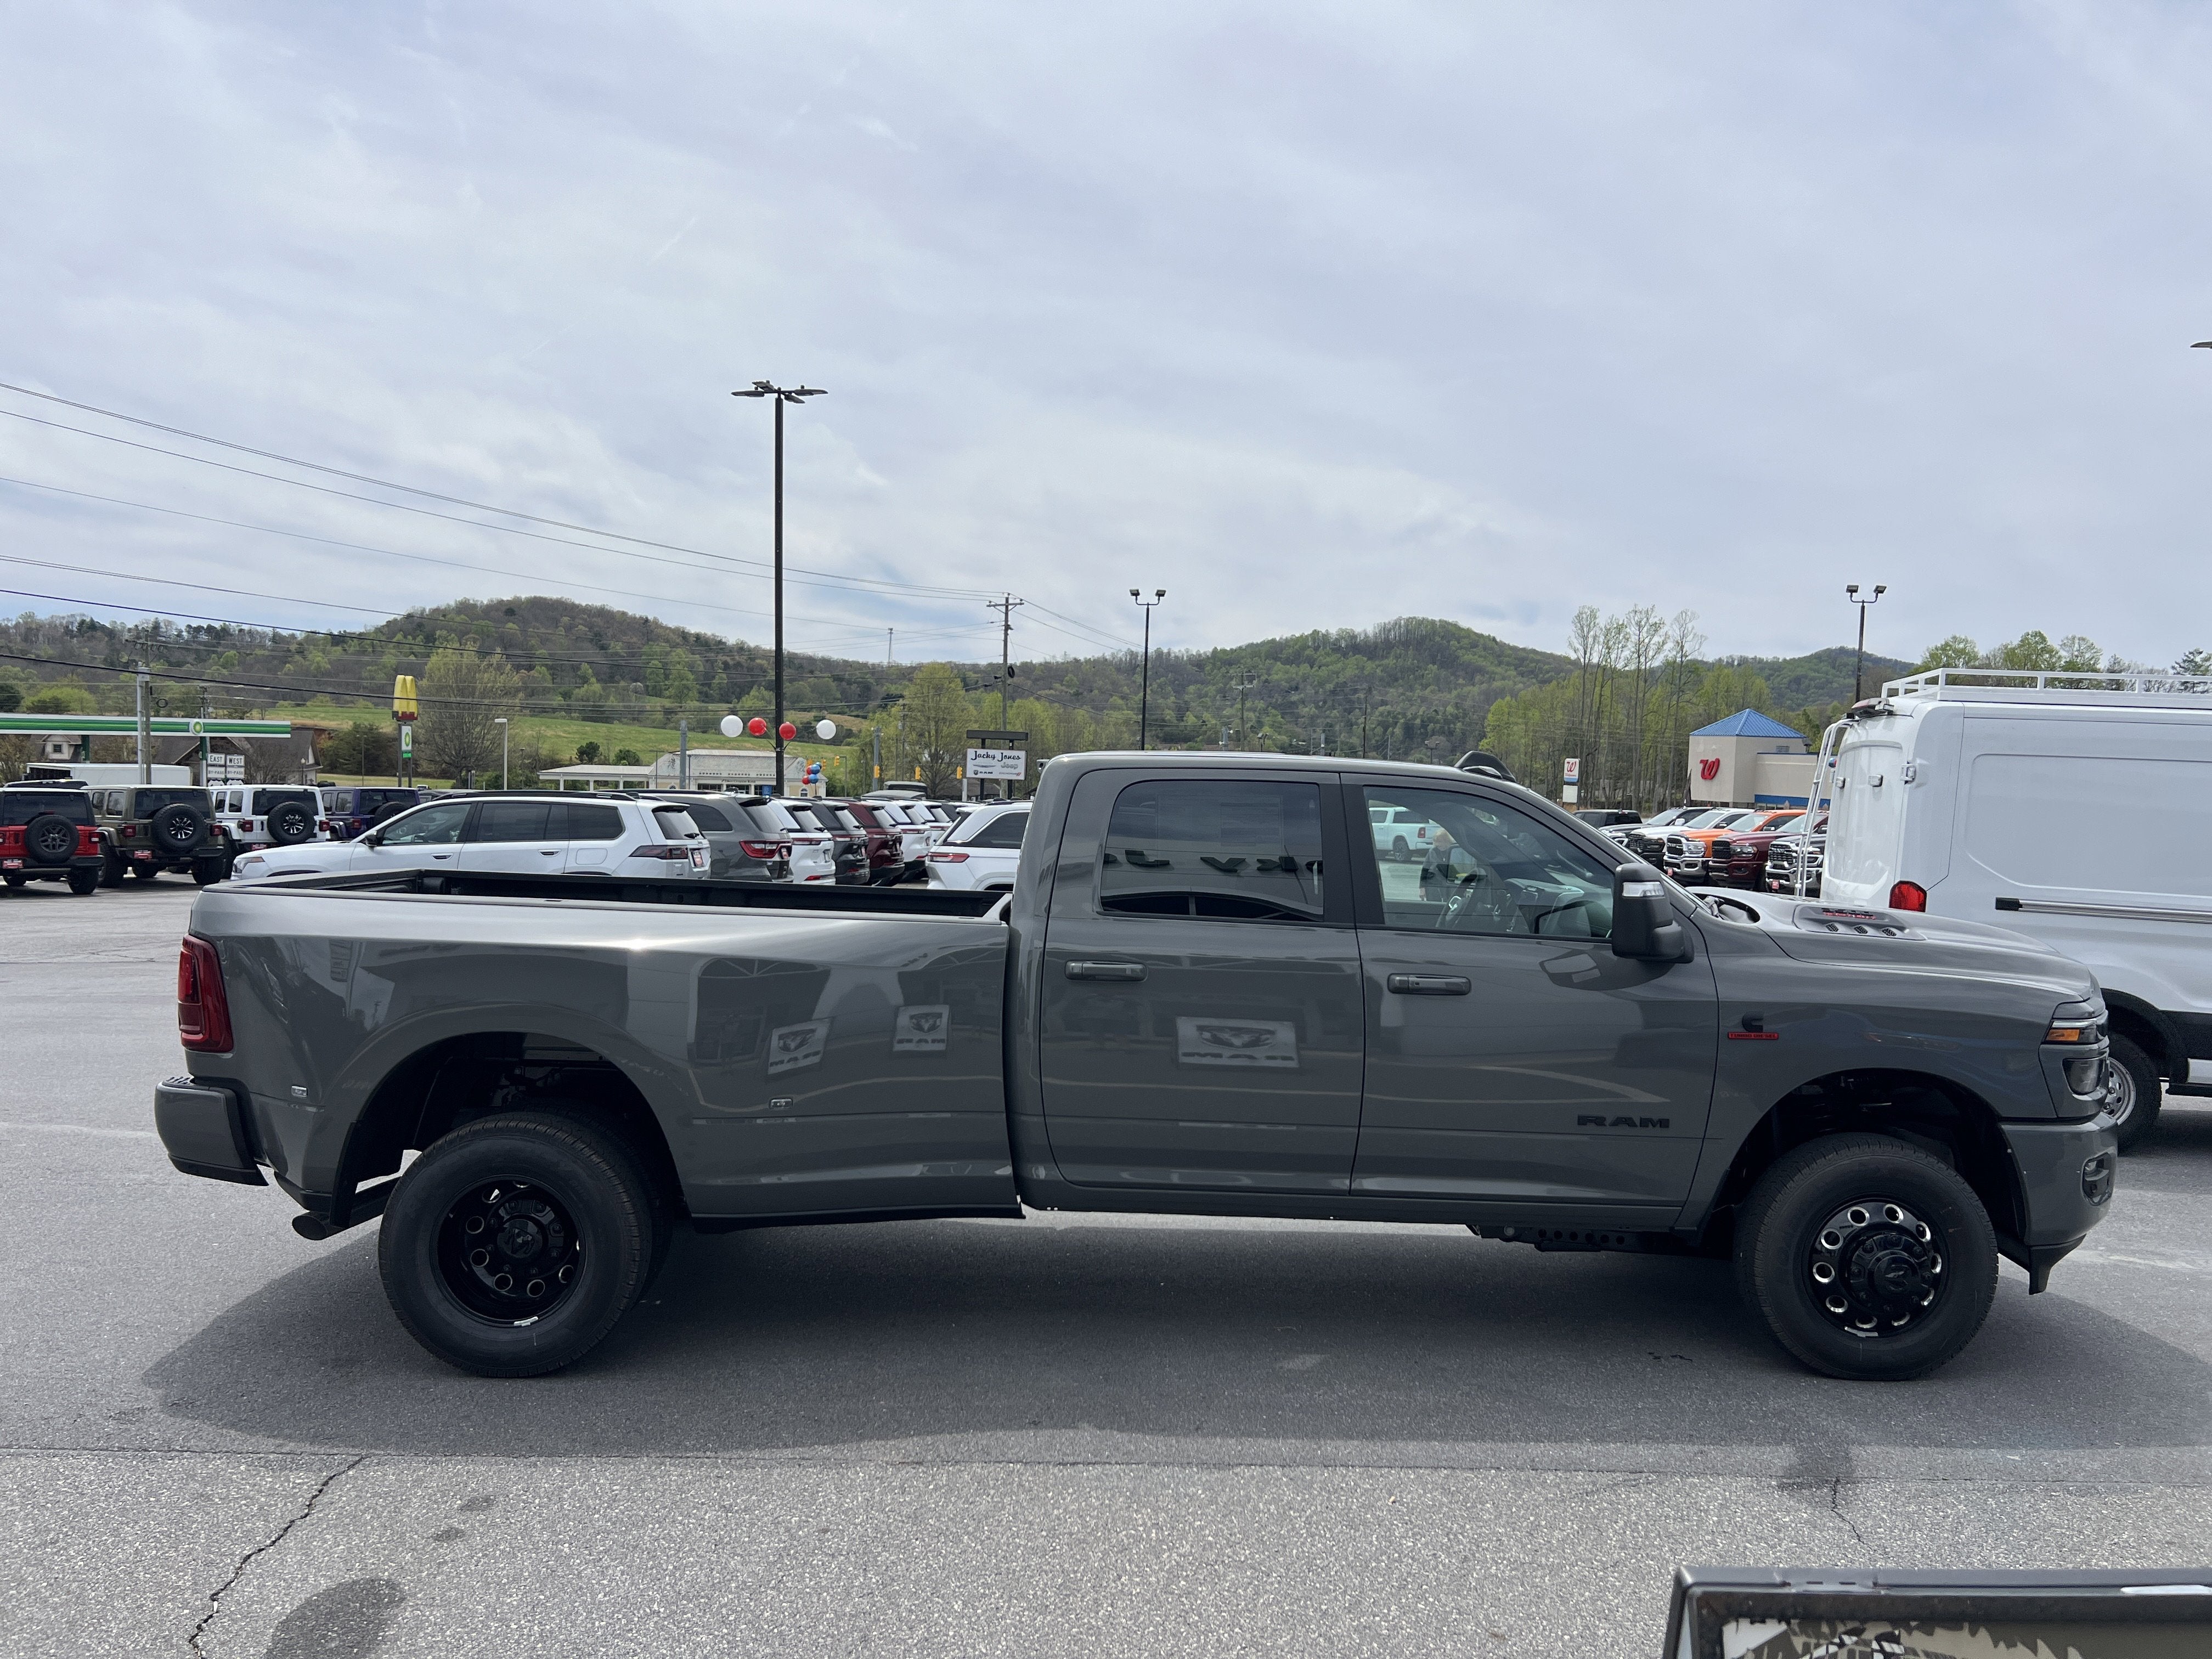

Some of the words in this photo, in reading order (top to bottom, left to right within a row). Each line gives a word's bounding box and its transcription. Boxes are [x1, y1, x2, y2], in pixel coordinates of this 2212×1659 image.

[970, 751, 996, 760] Jacky
[997, 752, 1021, 761] Jones
[1001, 761, 1018, 770] Jeep
[1577, 1114, 1669, 1128] RAM
